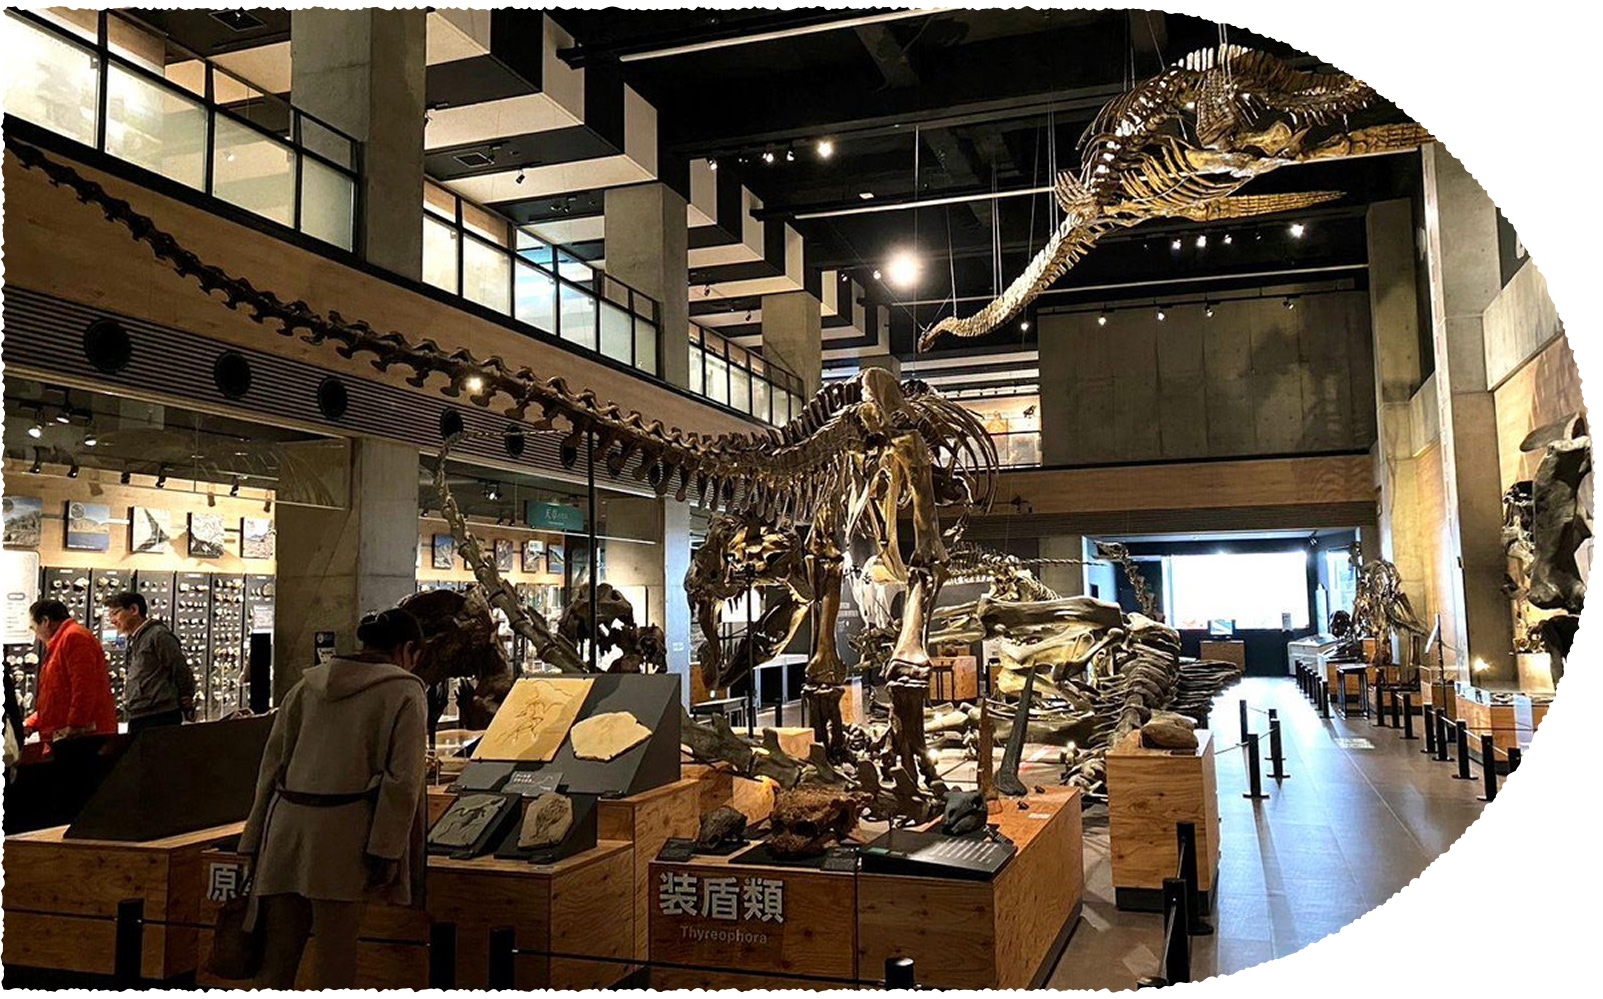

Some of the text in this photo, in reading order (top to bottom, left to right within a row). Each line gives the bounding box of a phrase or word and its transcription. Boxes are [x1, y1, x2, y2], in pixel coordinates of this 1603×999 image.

[206, 862, 252, 901] 原
[659, 872, 784, 923] 装盾類
[680, 925, 767, 943] Thyreophora
